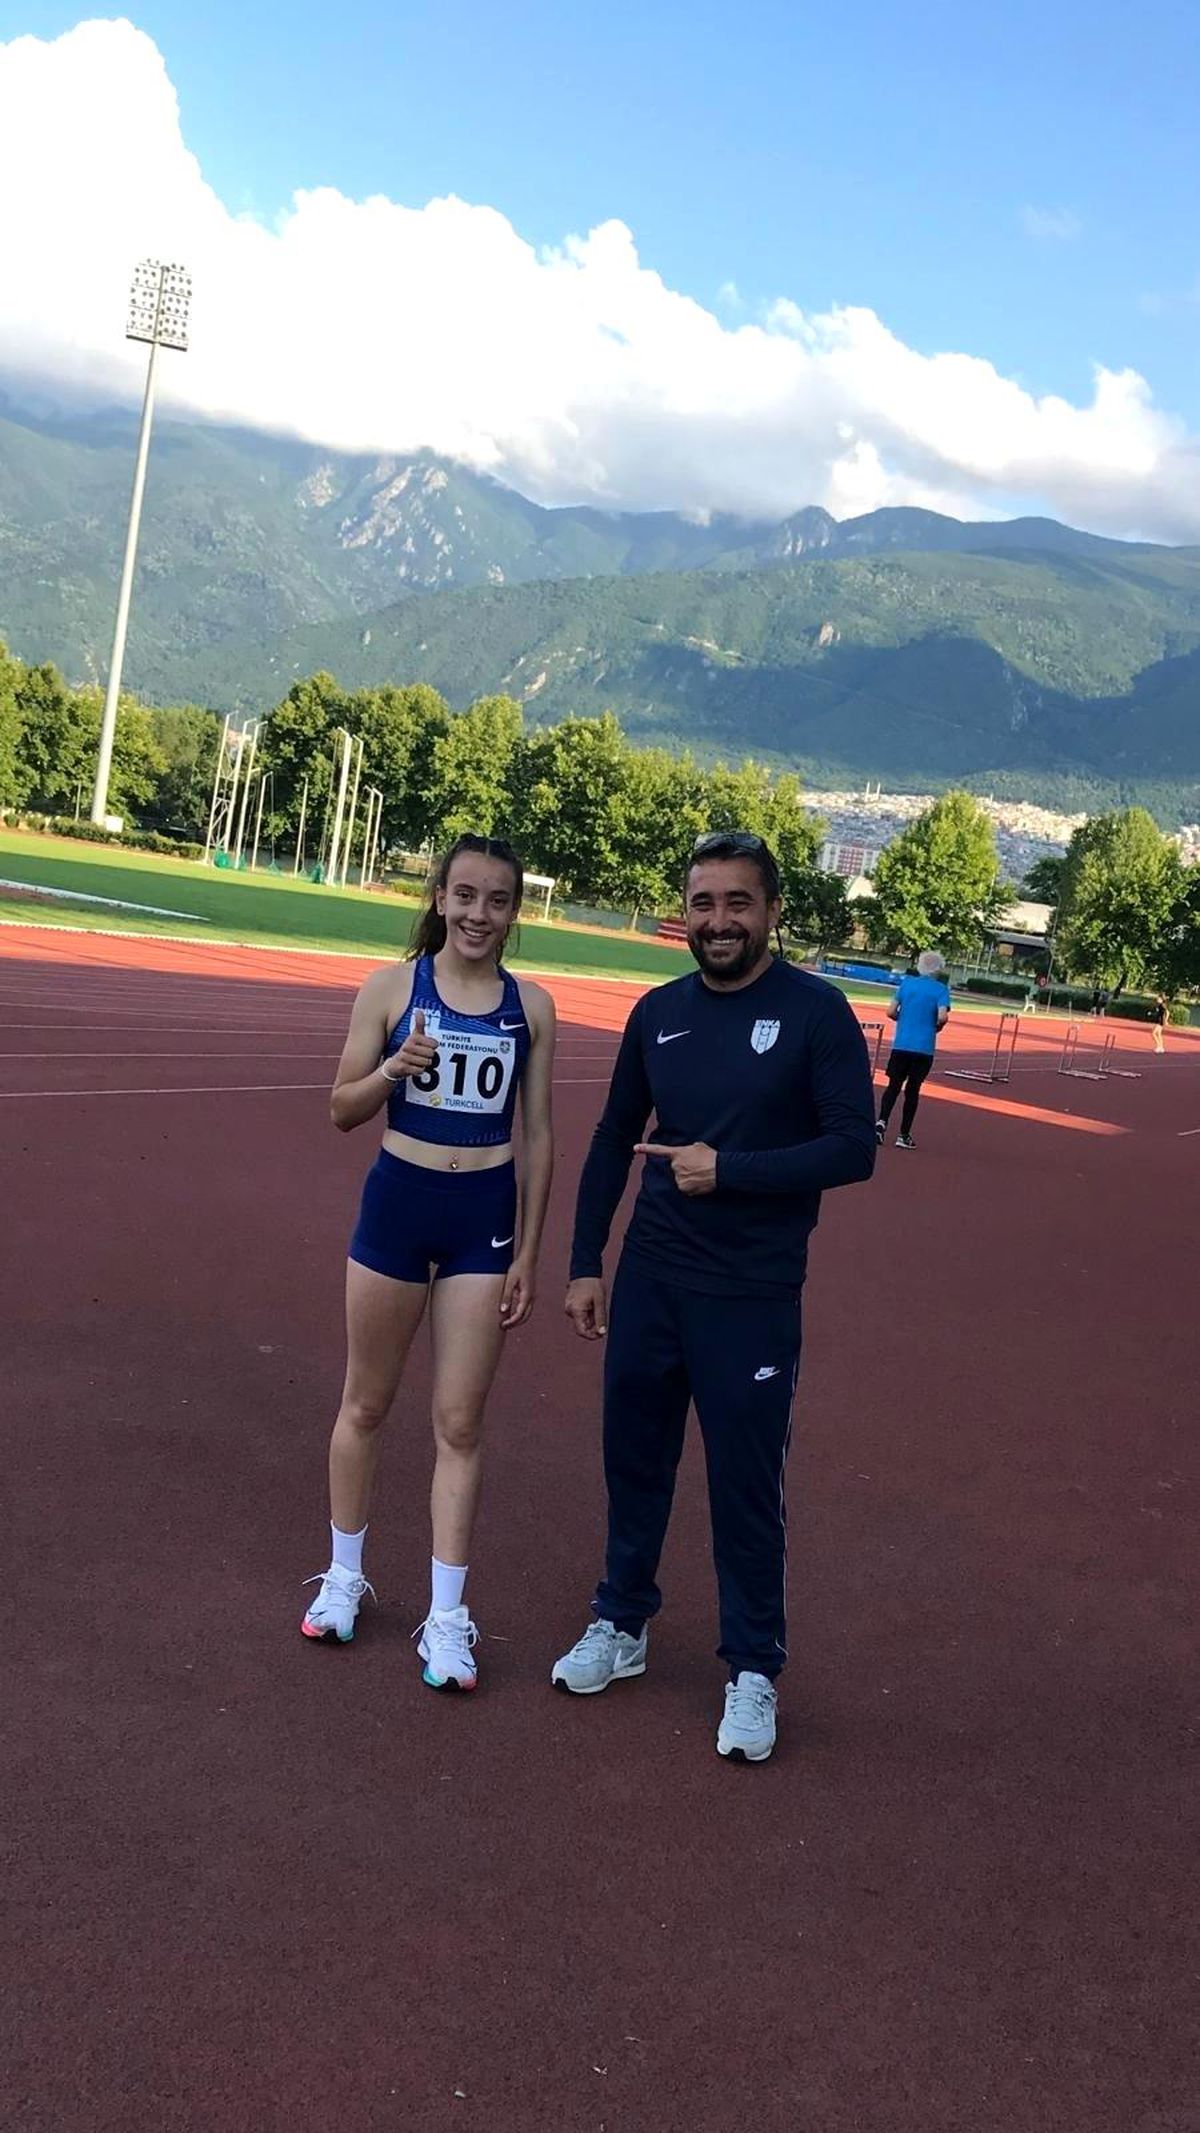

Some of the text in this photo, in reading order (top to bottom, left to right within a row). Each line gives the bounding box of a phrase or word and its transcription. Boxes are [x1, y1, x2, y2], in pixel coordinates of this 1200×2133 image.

[412, 1007, 441, 1017] EKA
[447, 1042, 498, 1054] FEDERASYONU
[444, 1098, 484, 1110] TURKCELL
